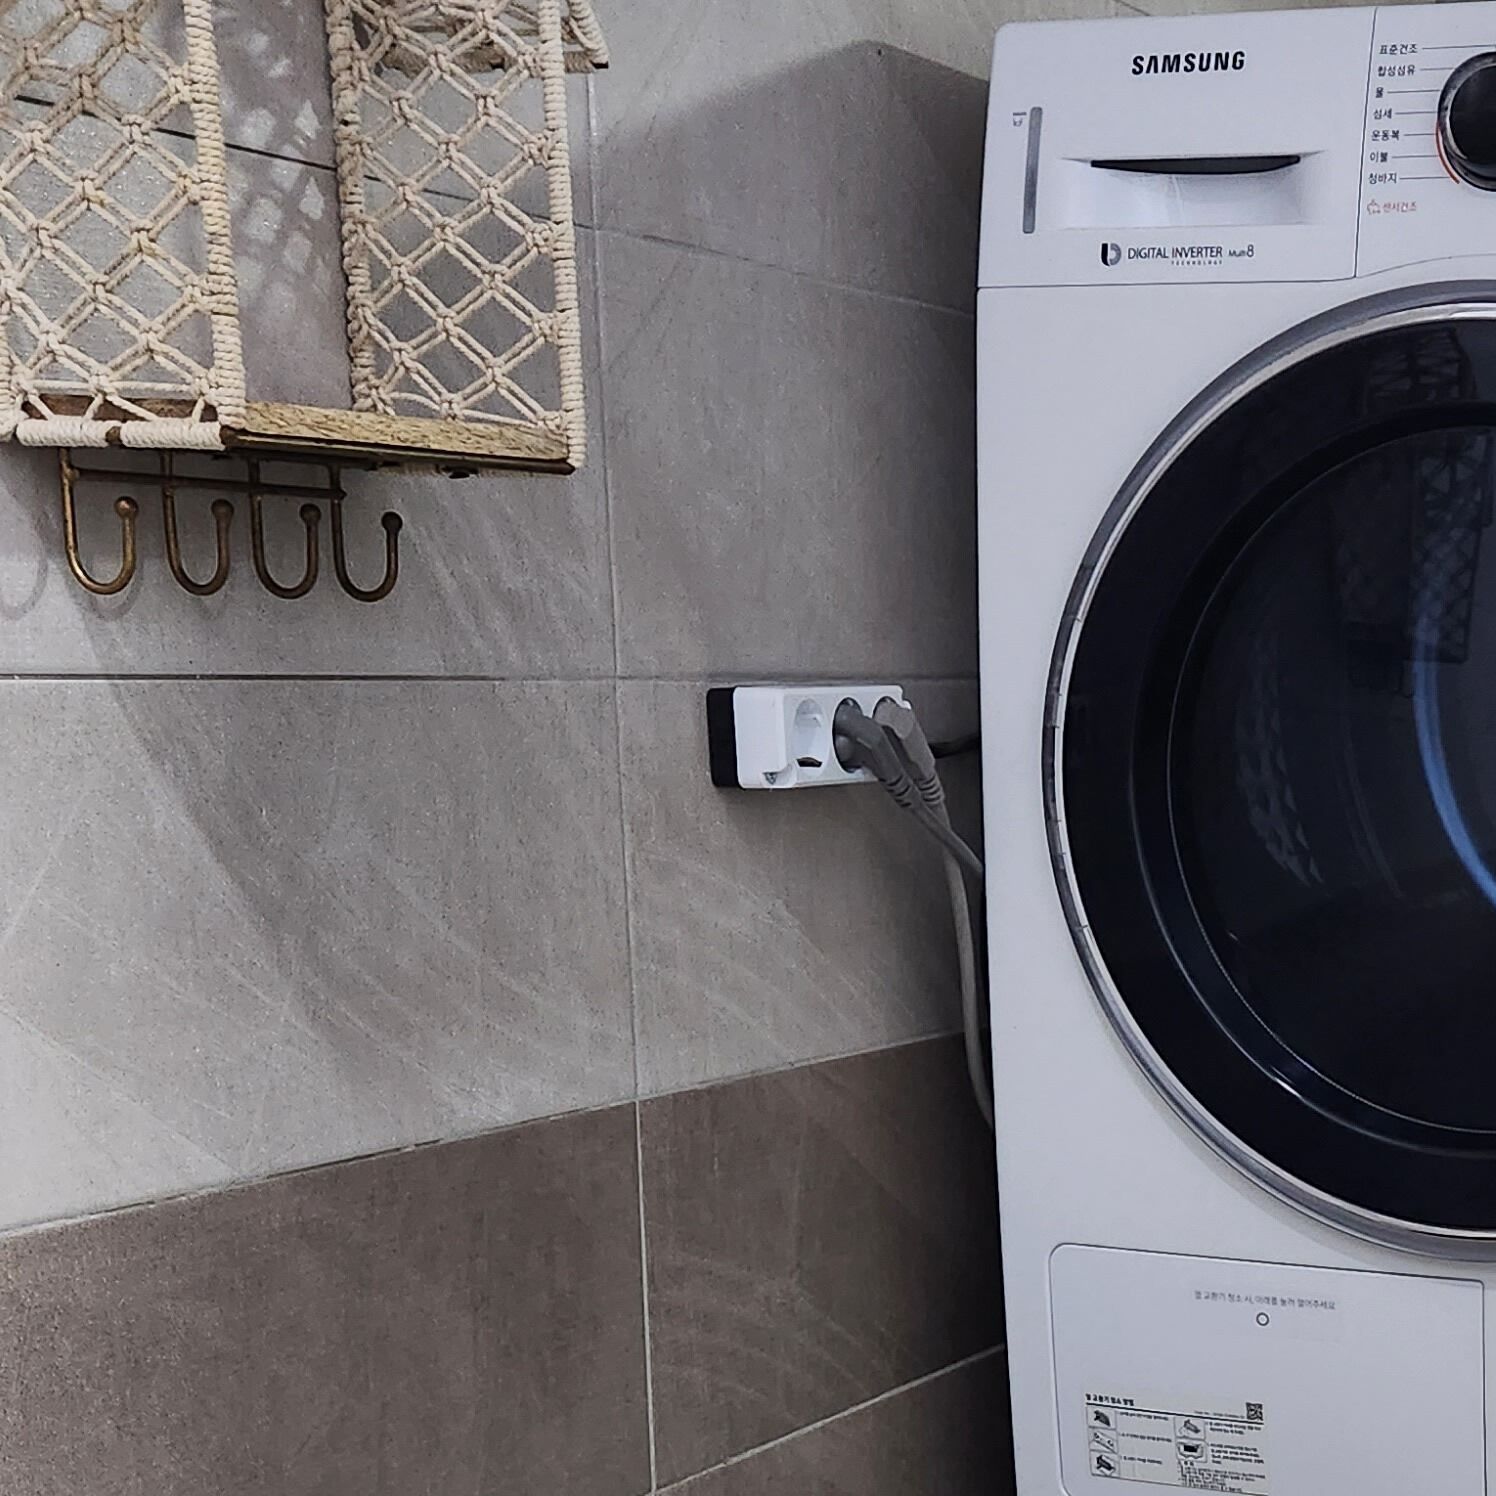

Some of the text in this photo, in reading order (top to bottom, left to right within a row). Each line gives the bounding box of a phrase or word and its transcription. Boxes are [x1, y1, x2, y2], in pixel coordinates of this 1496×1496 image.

[1379, 44, 1418, 55] 표준건조
[1131, 51, 1246, 75] SAMSUNG
[1377, 64, 1416, 77] 합성섬유
[1373, 108, 1392, 120] 섬세
[1371, 129, 1400, 141] 운동복
[1369, 151, 1388, 162] 이불
[1368, 173, 1397, 185] 청바지
[1127, 247, 1168, 260] DIGITAL
[1172, 246, 1223, 258] INVERTER
